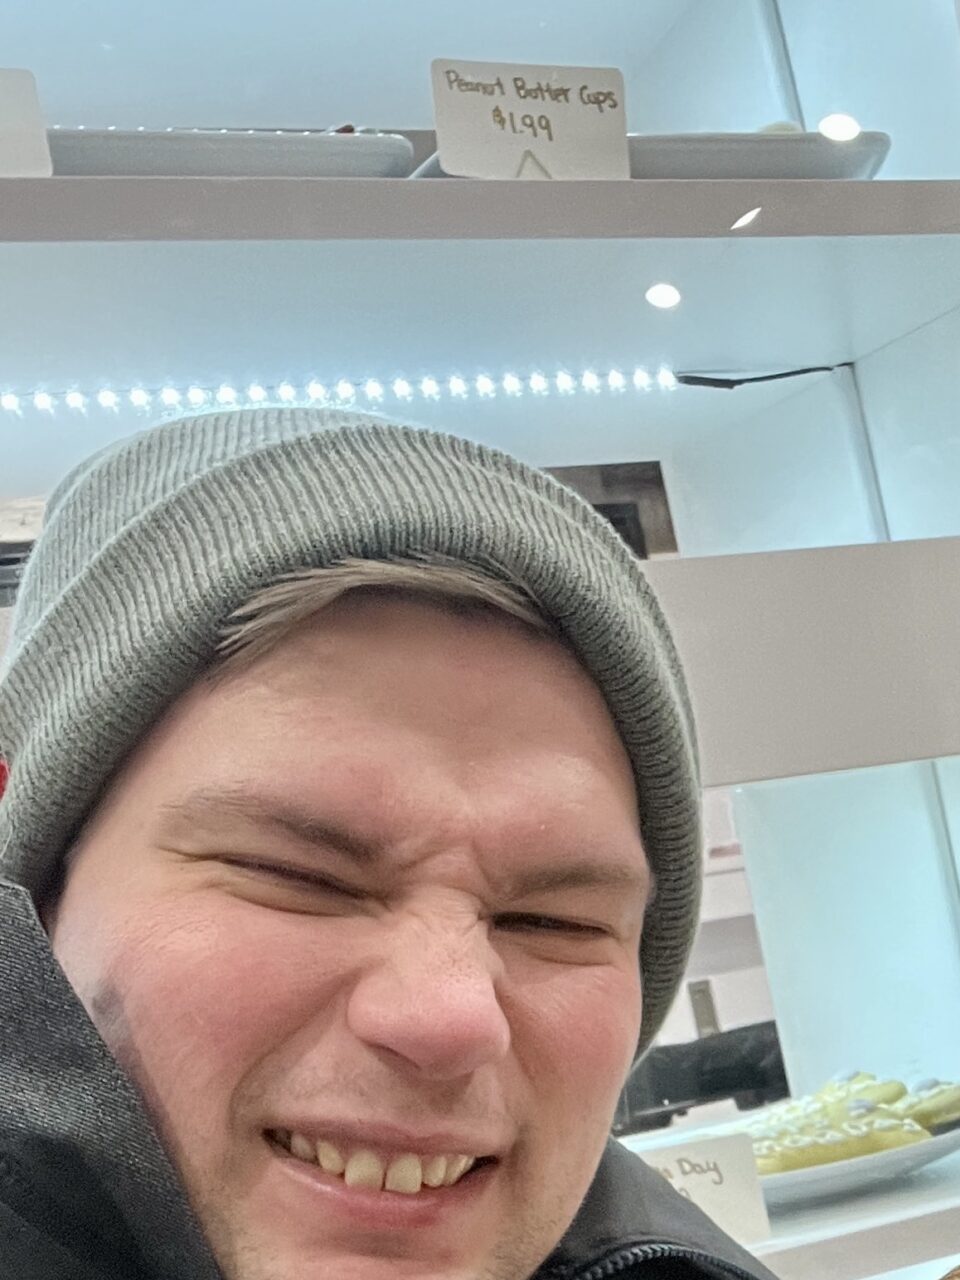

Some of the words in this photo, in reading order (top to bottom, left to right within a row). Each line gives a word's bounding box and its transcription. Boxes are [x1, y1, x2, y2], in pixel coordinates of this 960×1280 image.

[445, 69, 505, 96] Peanut
[579, 85, 618, 113] Cups
[492, 105, 554, 142] $1.99
[676, 1157, 724, 1186] Day
